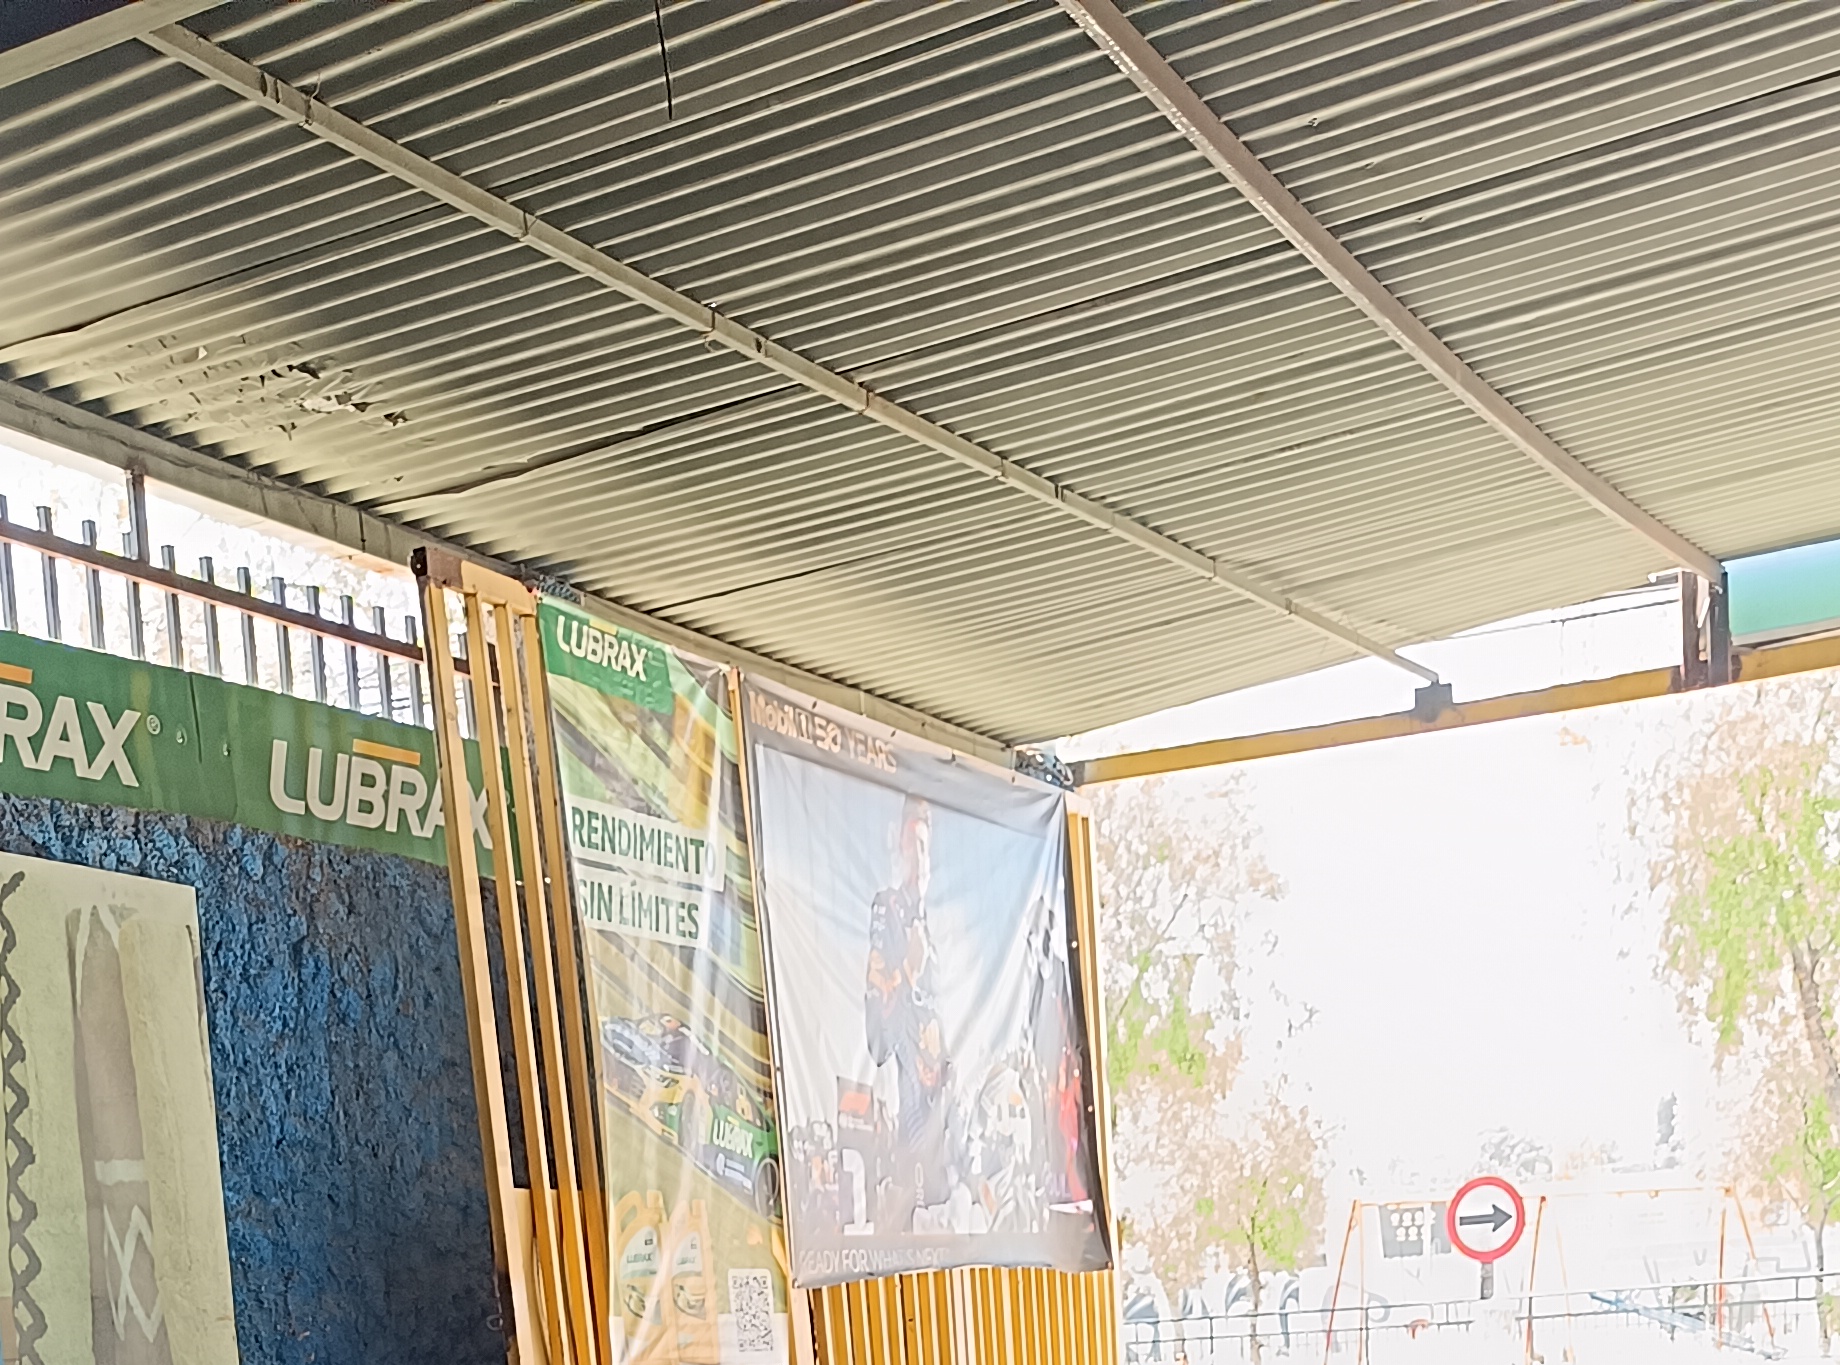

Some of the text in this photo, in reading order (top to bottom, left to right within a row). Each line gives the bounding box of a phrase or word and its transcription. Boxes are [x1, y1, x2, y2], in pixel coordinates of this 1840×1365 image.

[556, 614, 648, 682] LUBRAX
[844, 726, 897, 774] YEARS
[571, 805, 717, 878] RENDIMIENTO
[578, 878, 700, 940] SIN LÍMITES
[841, 1249, 870, 1273] FOR
